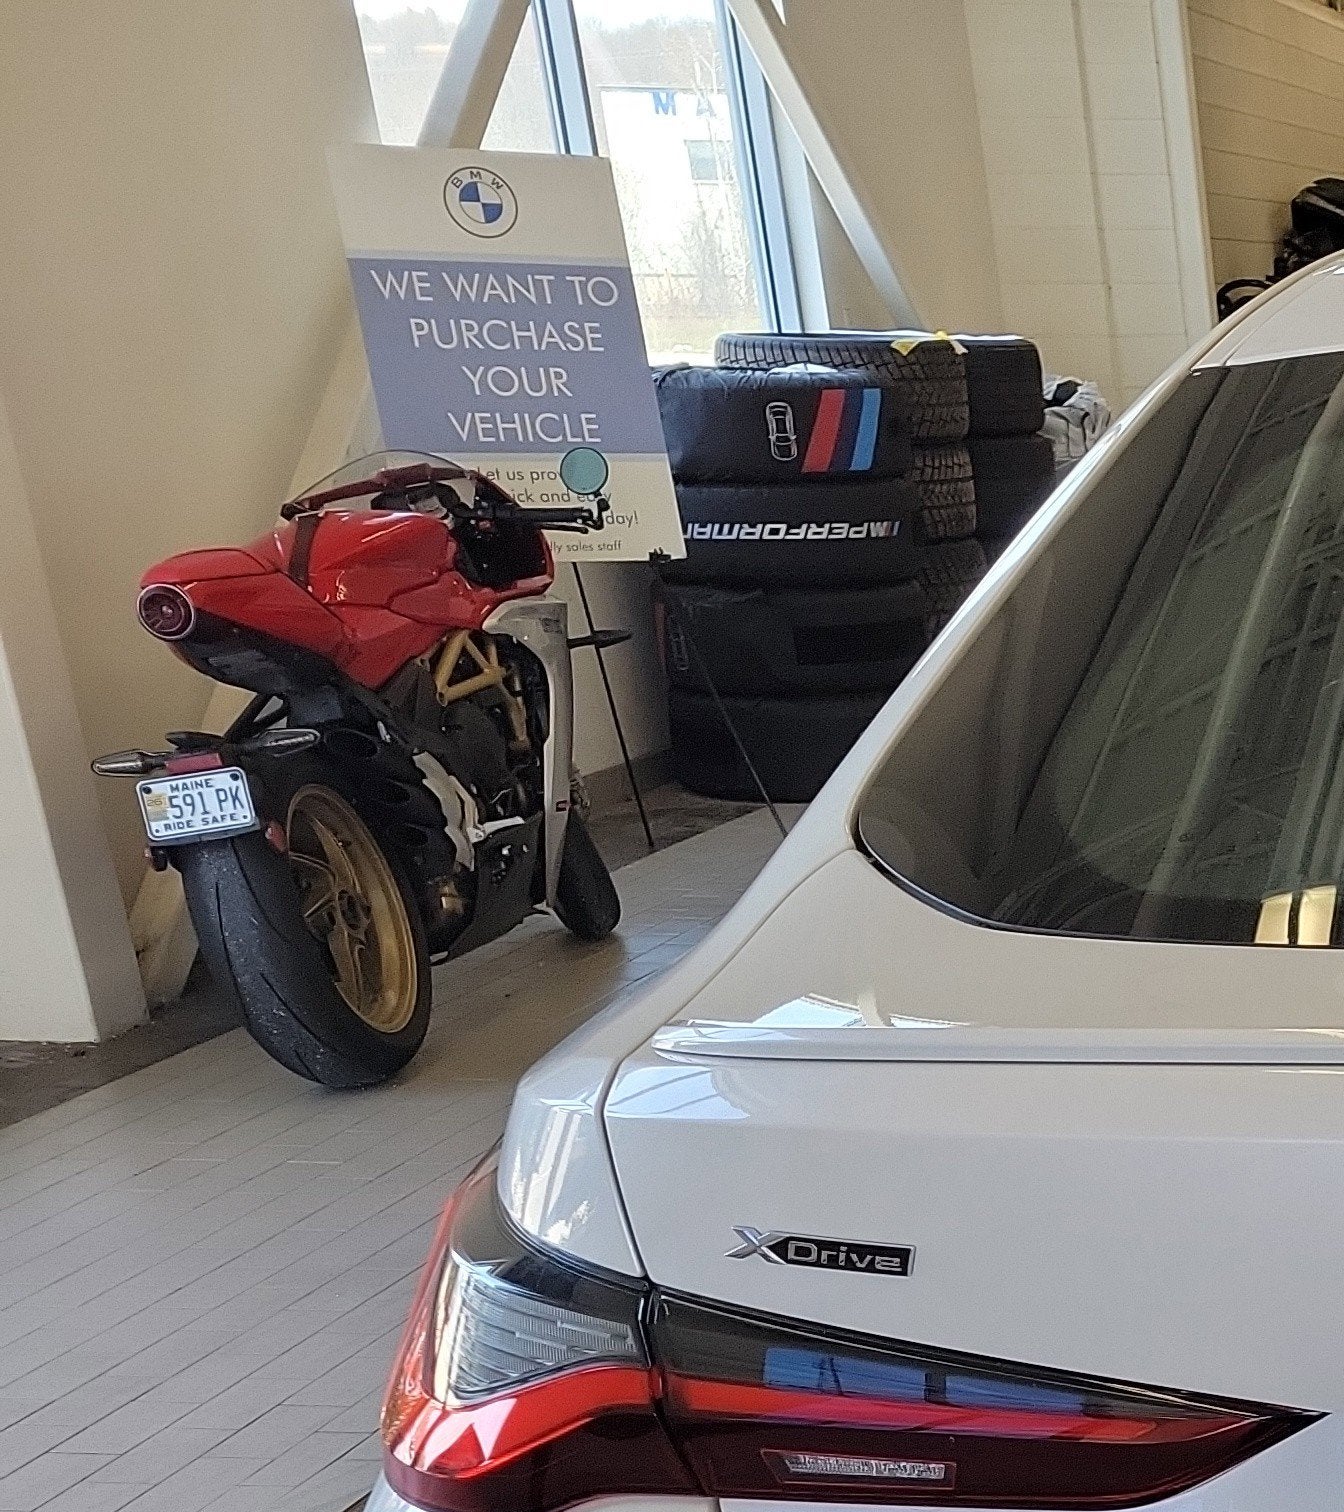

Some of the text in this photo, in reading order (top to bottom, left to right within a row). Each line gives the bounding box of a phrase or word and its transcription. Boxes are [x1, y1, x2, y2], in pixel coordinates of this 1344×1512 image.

[451, 170, 504, 191] BMW
[370, 269, 619, 307] WE WANT TO
[409, 318, 605, 352] PURCHASE
[461, 365, 573, 398] YOUR
[448, 412, 601, 443] VEHICLE
[506, 470, 525, 481] us
[540, 487, 571, 503] and
[566, 541, 594, 552] sales
[597, 540, 622, 552] staff
[170, 778, 215, 793] MAINE
[168, 785, 245, 819] 591 PK
[164, 813, 238, 832] RIDE SAFE
